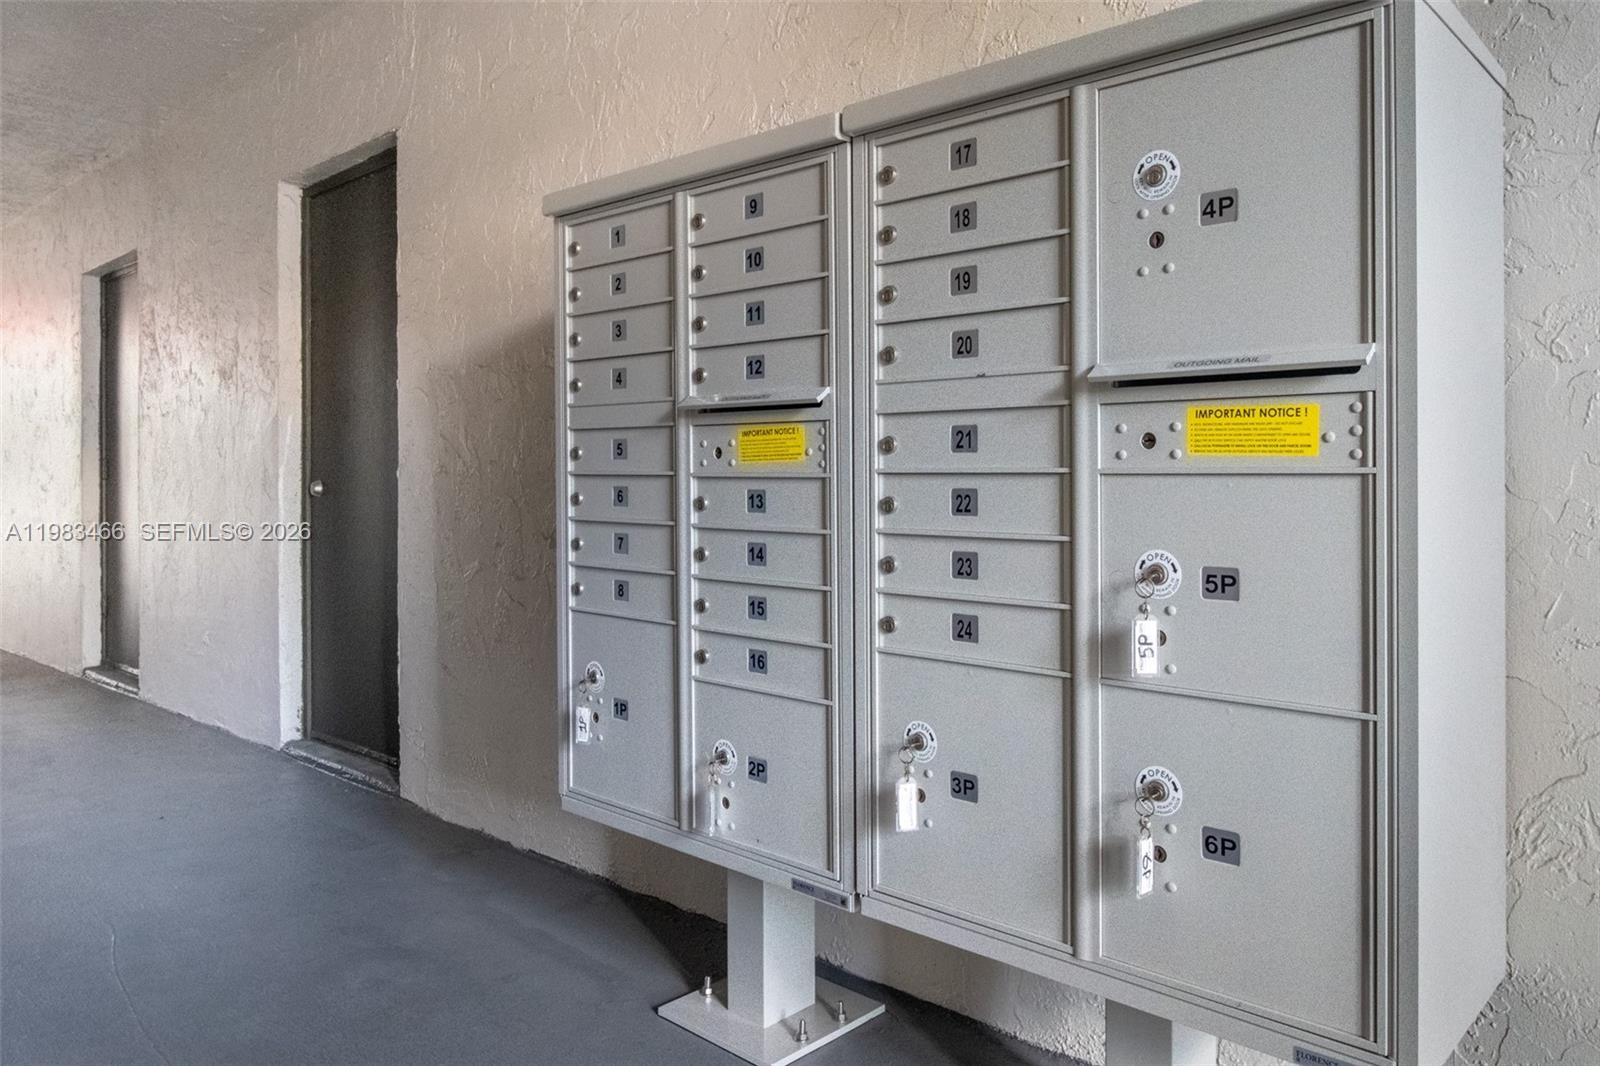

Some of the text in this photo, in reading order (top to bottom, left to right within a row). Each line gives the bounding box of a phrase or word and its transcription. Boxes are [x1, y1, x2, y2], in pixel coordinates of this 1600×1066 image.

[954, 143, 972, 166] 17
[1145, 153, 1170, 164] OPEN
[748, 198, 759, 215] 9
[1201, 195, 1235, 219] 4P
[953, 207, 971, 230] 18
[614, 229, 621, 244] 1
[746, 251, 762, 269] 10
[614, 276, 622, 292] 2
[954, 270, 972, 292] 19
[746, 304, 761, 323] 11
[614, 323, 623, 339] 3
[956, 334, 973, 356] 20
[746, 358, 763, 376] 12
[1173, 356, 1260, 368] OUTGOING MAIL
[615, 371, 623, 386] 4
[1195, 408, 1256, 419] IMPORTANT
[1259, 407, 1301, 418] NOTICE
[741, 428, 773, 437] IMPORTANT
[774, 427, 796, 435] NOTICE
[955, 429, 972, 450] 21
[616, 442, 624, 457] 5
[616, 488, 624, 504] 6
[748, 493, 765, 510] 13
[955, 493, 972, 514] 22
[616, 536, 625, 551] 7
[748, 545, 765, 563] 14
[1146, 552, 1172, 563] OPEN
[956, 556, 973, 577] 23
[617, 583, 625, 598] 8
[1204, 573, 1238, 595] 5P
[748, 599, 766, 617] 15
[956, 618, 973, 640] 24
[1137, 634, 1155, 658] 5P
[749, 652, 766, 671] 16
[613, 701, 628, 717] 1P
[911, 722, 930, 733] OPEN
[748, 760, 766, 778] 2P
[1147, 769, 1172, 781] OPEN
[951, 776, 976, 796] 3P
[1204, 834, 1238, 857] 6P
